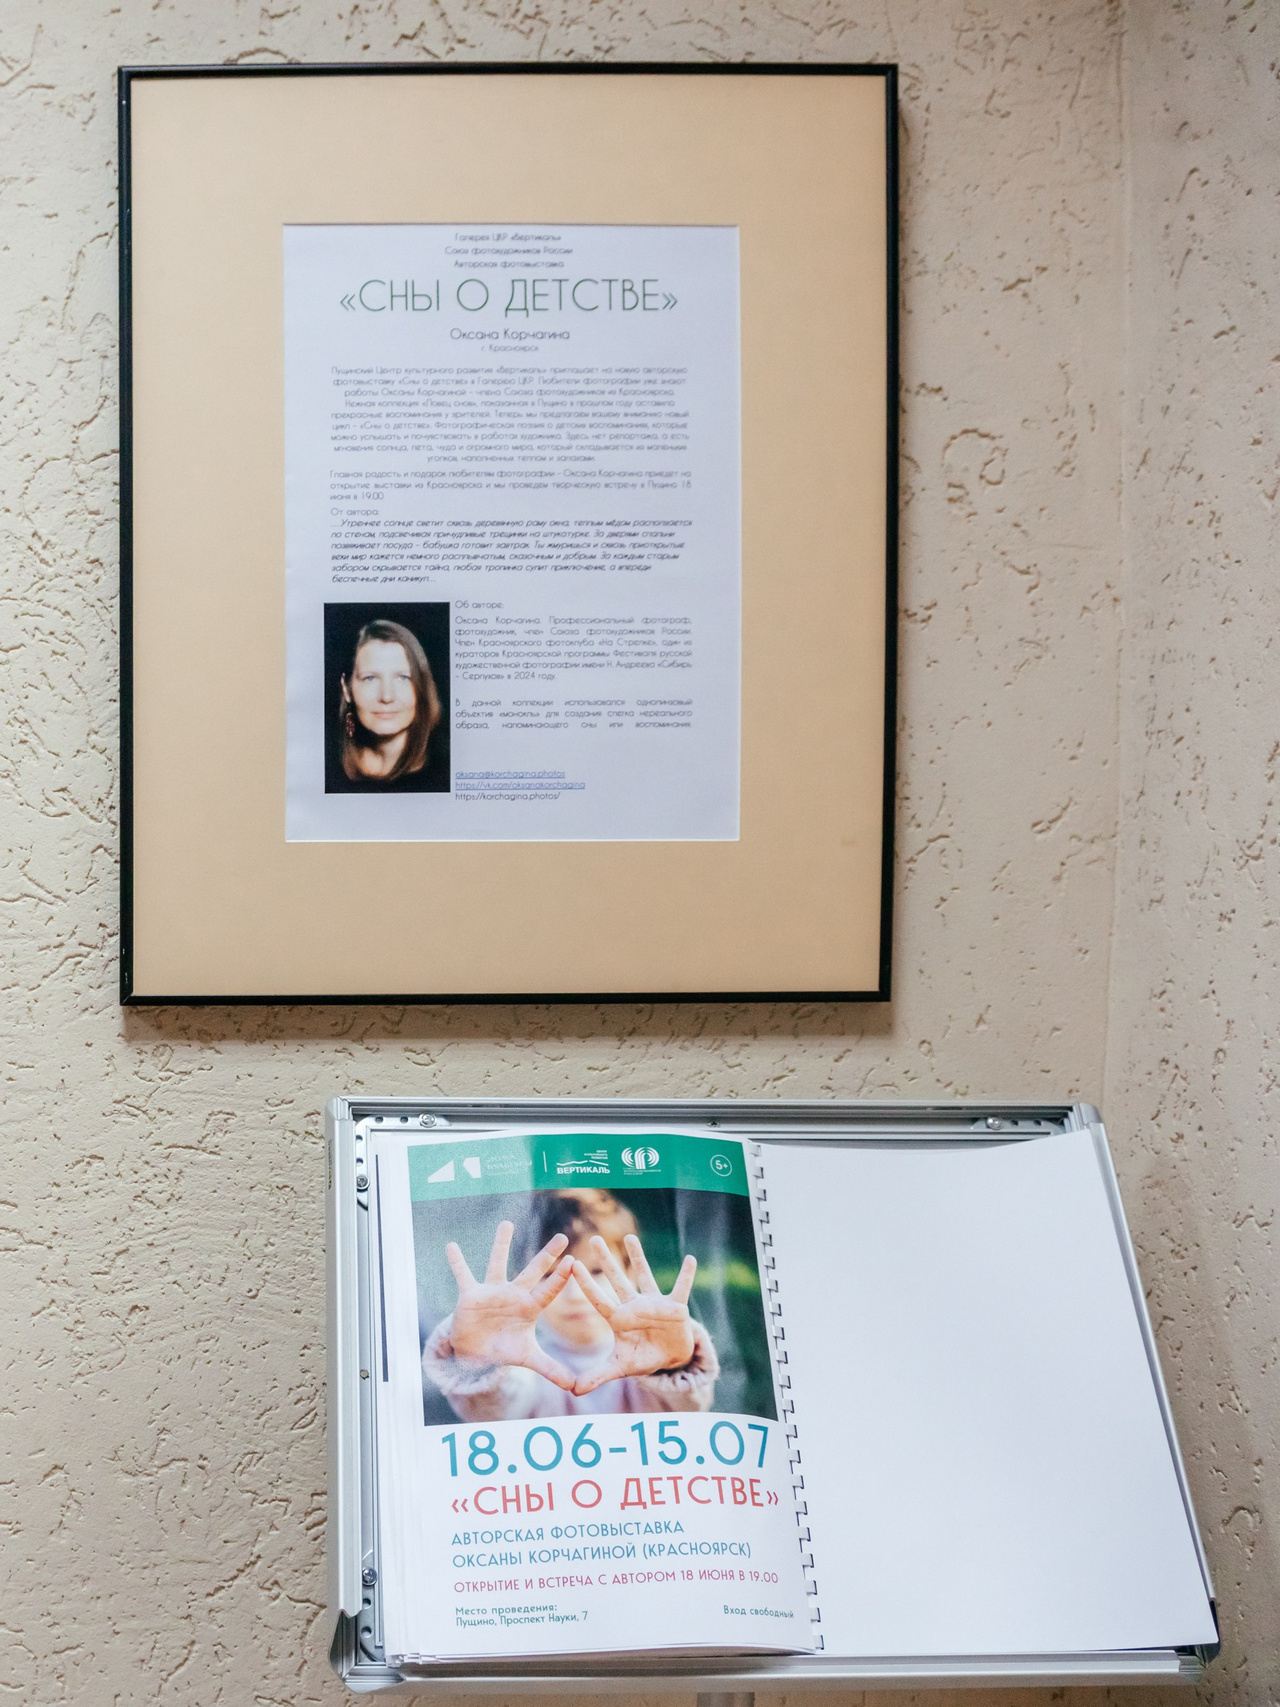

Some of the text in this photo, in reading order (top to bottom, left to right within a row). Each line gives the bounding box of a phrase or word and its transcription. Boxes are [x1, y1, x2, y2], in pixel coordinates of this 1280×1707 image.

[340, 278, 678, 318] «СНЫ О ДЕТСТВЕ»
[450, 326, 570, 343] Оксана Корчагина
[456, 770, 565, 779] oksana@korchagina.photos
[456, 782, 586, 790] https://vk.com/oksanakorchagina
[456, 792, 560, 801] https://korchagina.photos/
[715, 1160, 728, 1170] 5+
[442, 1421, 768, 1476] 18.06-15.07
[452, 1476, 779, 1514] «СНЫ О ДЕТСТВЕ»
[452, 1521, 684, 1545] АВТОРСКАЯ ФОТОВЫСТАВКА
[452, 1542, 751, 1568] ОКСАНЫ КОРЧАГИНОЙ (КРАСНОЯРСК)
[454, 1569, 779, 1593] ОТКРЫТИЕ И ВСТРЕЧА С АВТОРОМ 18 ИЮНЯ В 19.00
[455, 1605, 558, 1616] Место проведения:
[723, 1606, 794, 1619] Вход свободный
[456, 1611, 588, 1627] Пущино, Проспект Науки, 7
